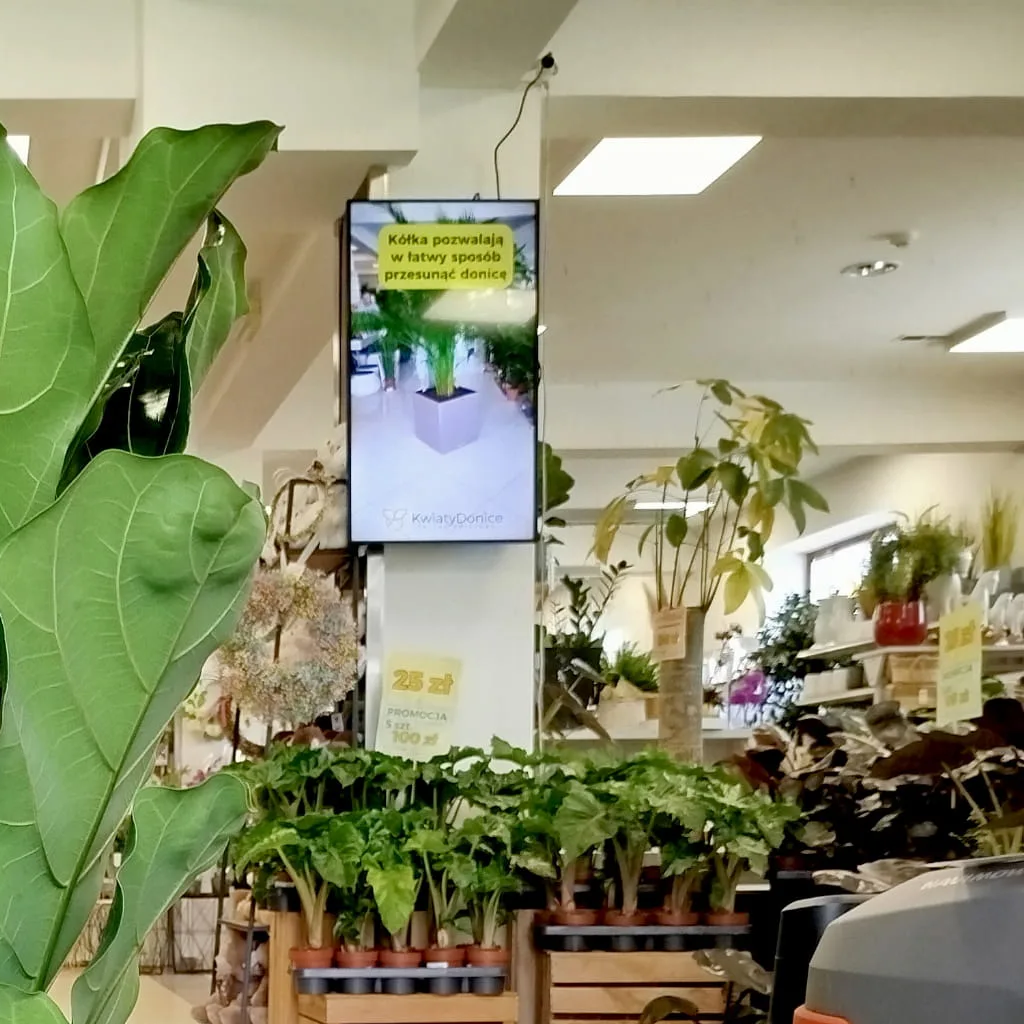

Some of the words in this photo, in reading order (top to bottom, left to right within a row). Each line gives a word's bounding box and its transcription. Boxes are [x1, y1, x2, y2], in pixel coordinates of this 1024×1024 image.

[388, 233, 428, 246] Kółka
[432, 233, 504, 248] pozwalają
[391, 253, 404, 263] w
[408, 251, 447, 265] łatwy
[451, 251, 501, 265] sposób
[384, 268, 456, 282] przesunąć
[460, 268, 507, 281] donicę
[411, 512, 503, 525] KwiatyDonice
[392, 669, 424, 692] 25
[428, 672, 454, 696] zł
[387, 707, 447, 721] PROMOCJA
